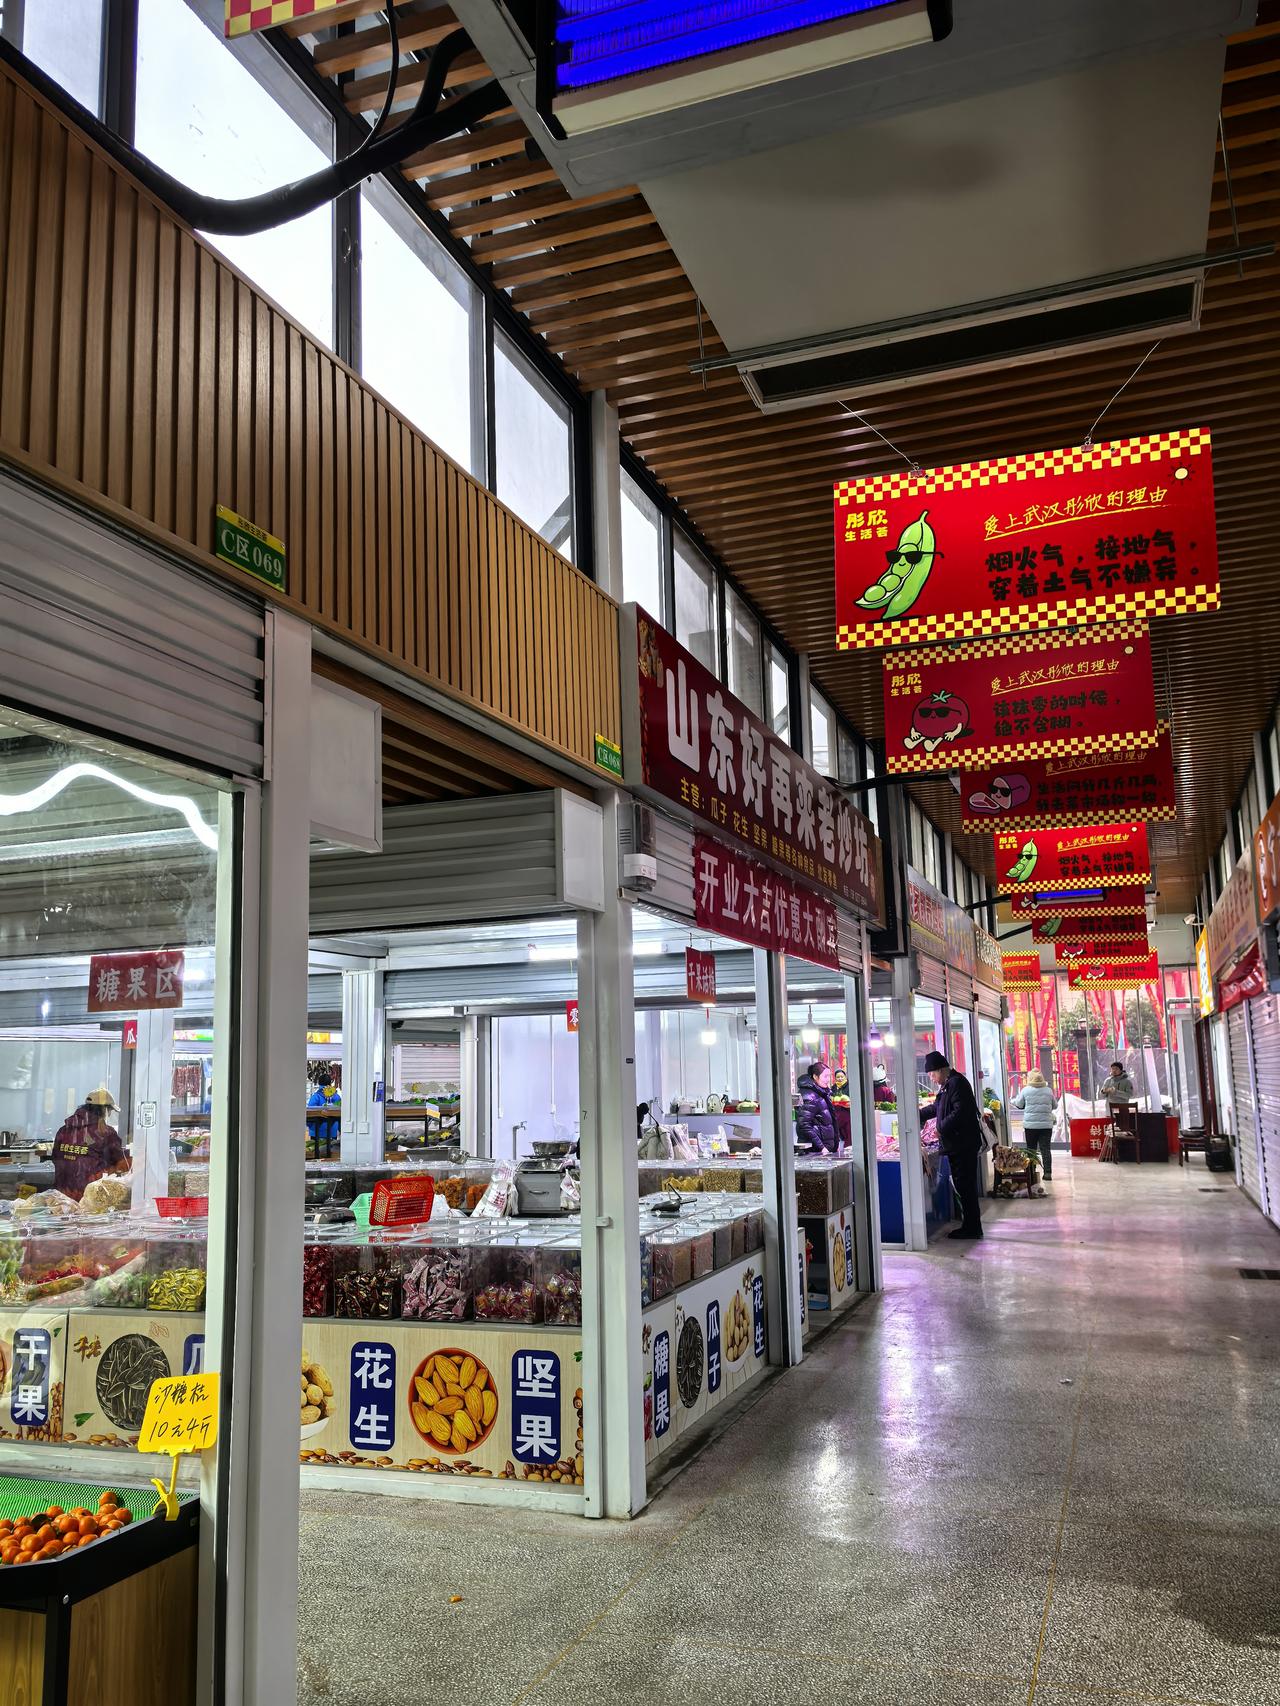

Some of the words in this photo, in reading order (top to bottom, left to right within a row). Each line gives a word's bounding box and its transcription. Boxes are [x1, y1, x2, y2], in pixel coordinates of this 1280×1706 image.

[844, 526, 888, 542] 生活荟
[845, 509, 888, 529] 彤欣
[984, 485, 1168, 537] 爱上武汉彤欣的理由
[221, 528, 283, 578] C区069
[891, 673, 922, 687] 彤欣
[990, 658, 1120, 693] 爱上武汉彤欣的理由
[665, 658, 869, 888] 山东好再来老炒坊
[1045, 750, 1147, 774] 爱上武汉彤欣的理由
[710, 797, 728, 825] 瓜子
[733, 810, 749, 838] 花生
[753, 823, 768, 849] 坚果
[699, 851, 838, 957] 开业大吉优惠大酬宾
[96, 966, 178, 1002] 糖果区
[753, 1280, 765, 1354] 花生
[707, 1305, 721, 1387] 瓜子
[14, 1335, 47, 1422] 干果
[353, 1348, 394, 1446] 花生
[654, 1336, 670, 1431] 糖果
[149, 1415, 213, 1446] 10元4斤
[515, 1356, 558, 1458] 坚果
